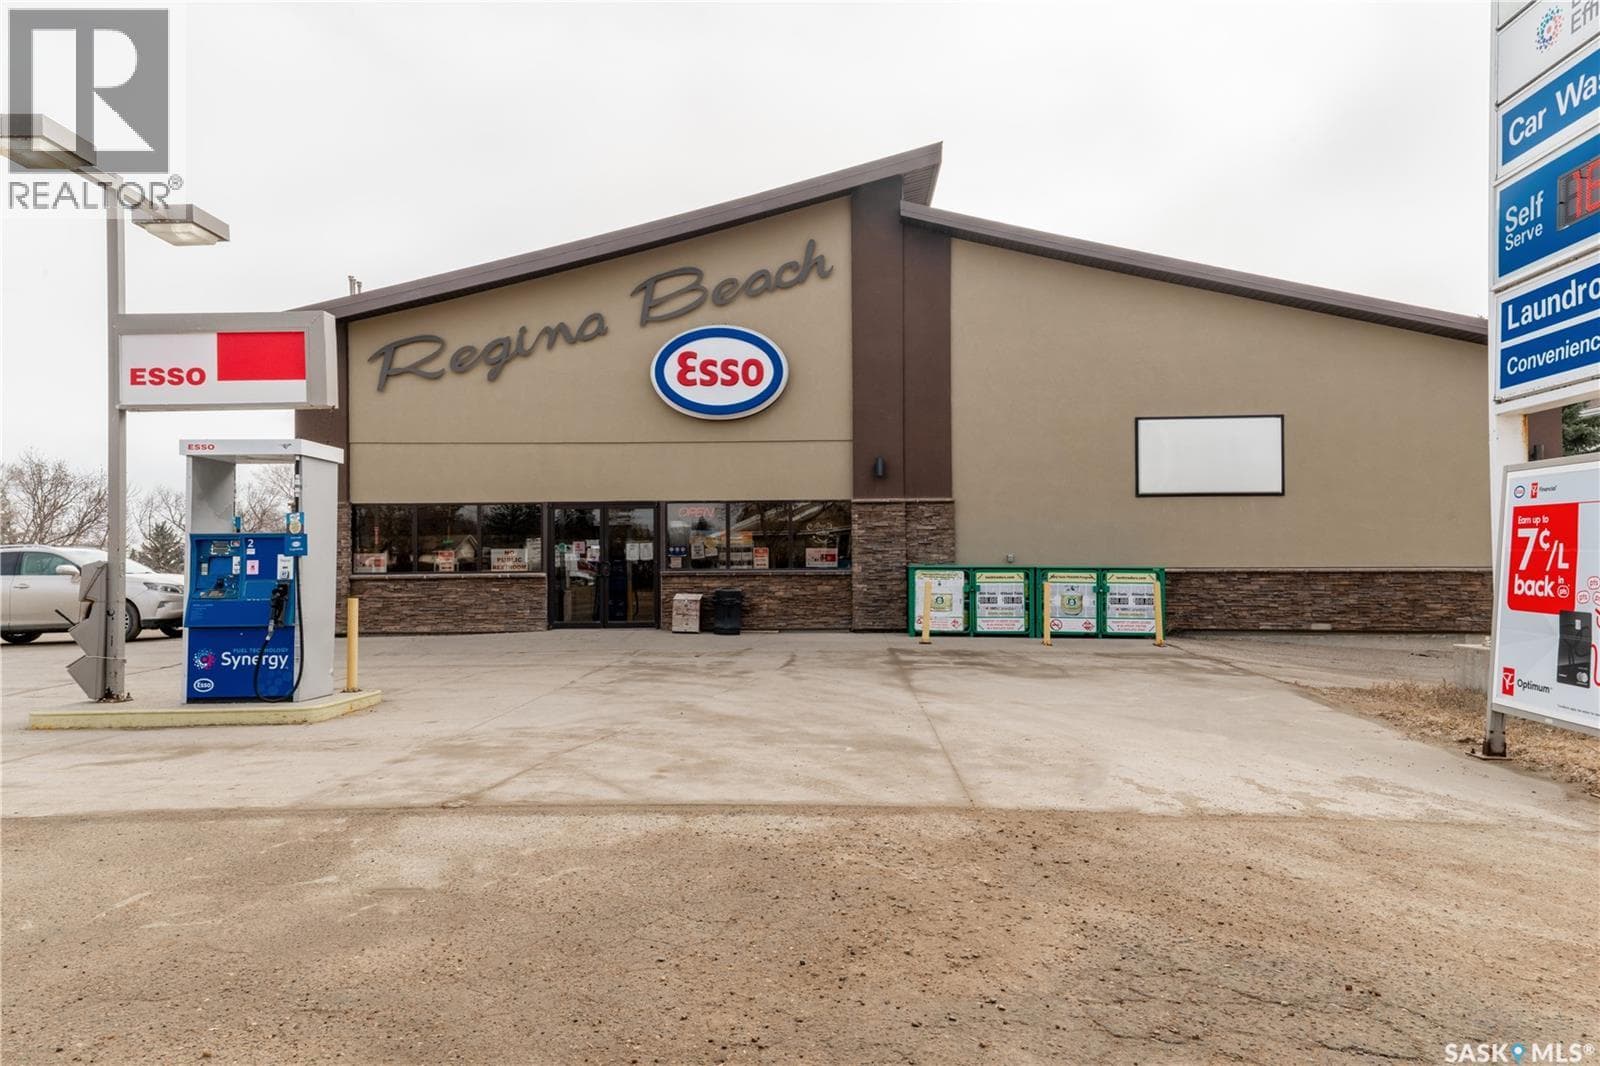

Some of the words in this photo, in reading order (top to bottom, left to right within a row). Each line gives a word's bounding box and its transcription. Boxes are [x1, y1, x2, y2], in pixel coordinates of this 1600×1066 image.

[1508, 107, 1547, 146] Car
[1555, 74, 1600, 116] Wa
[1505, 189, 1544, 233] Self
[1505, 223, 1543, 251] Serve
[367, 312, 608, 393] Regina
[630, 238, 834, 327] Beach
[1508, 277, 1600, 330] Laundro
[1507, 335, 1600, 375] Convenienc
[130, 367, 206, 386] ESSO
[676, 350, 764, 388] Esso
[187, 443, 215, 451] ESSO
[1518, 515, 1532, 525] Earn
[1533, 517, 1541, 526] up
[1542, 514, 1549, 524] to
[247, 539, 254, 548] 2
[1514, 574, 1555, 597] back
[221, 651, 289, 670] Synergy
[1517, 678, 1550, 694] Optimum
